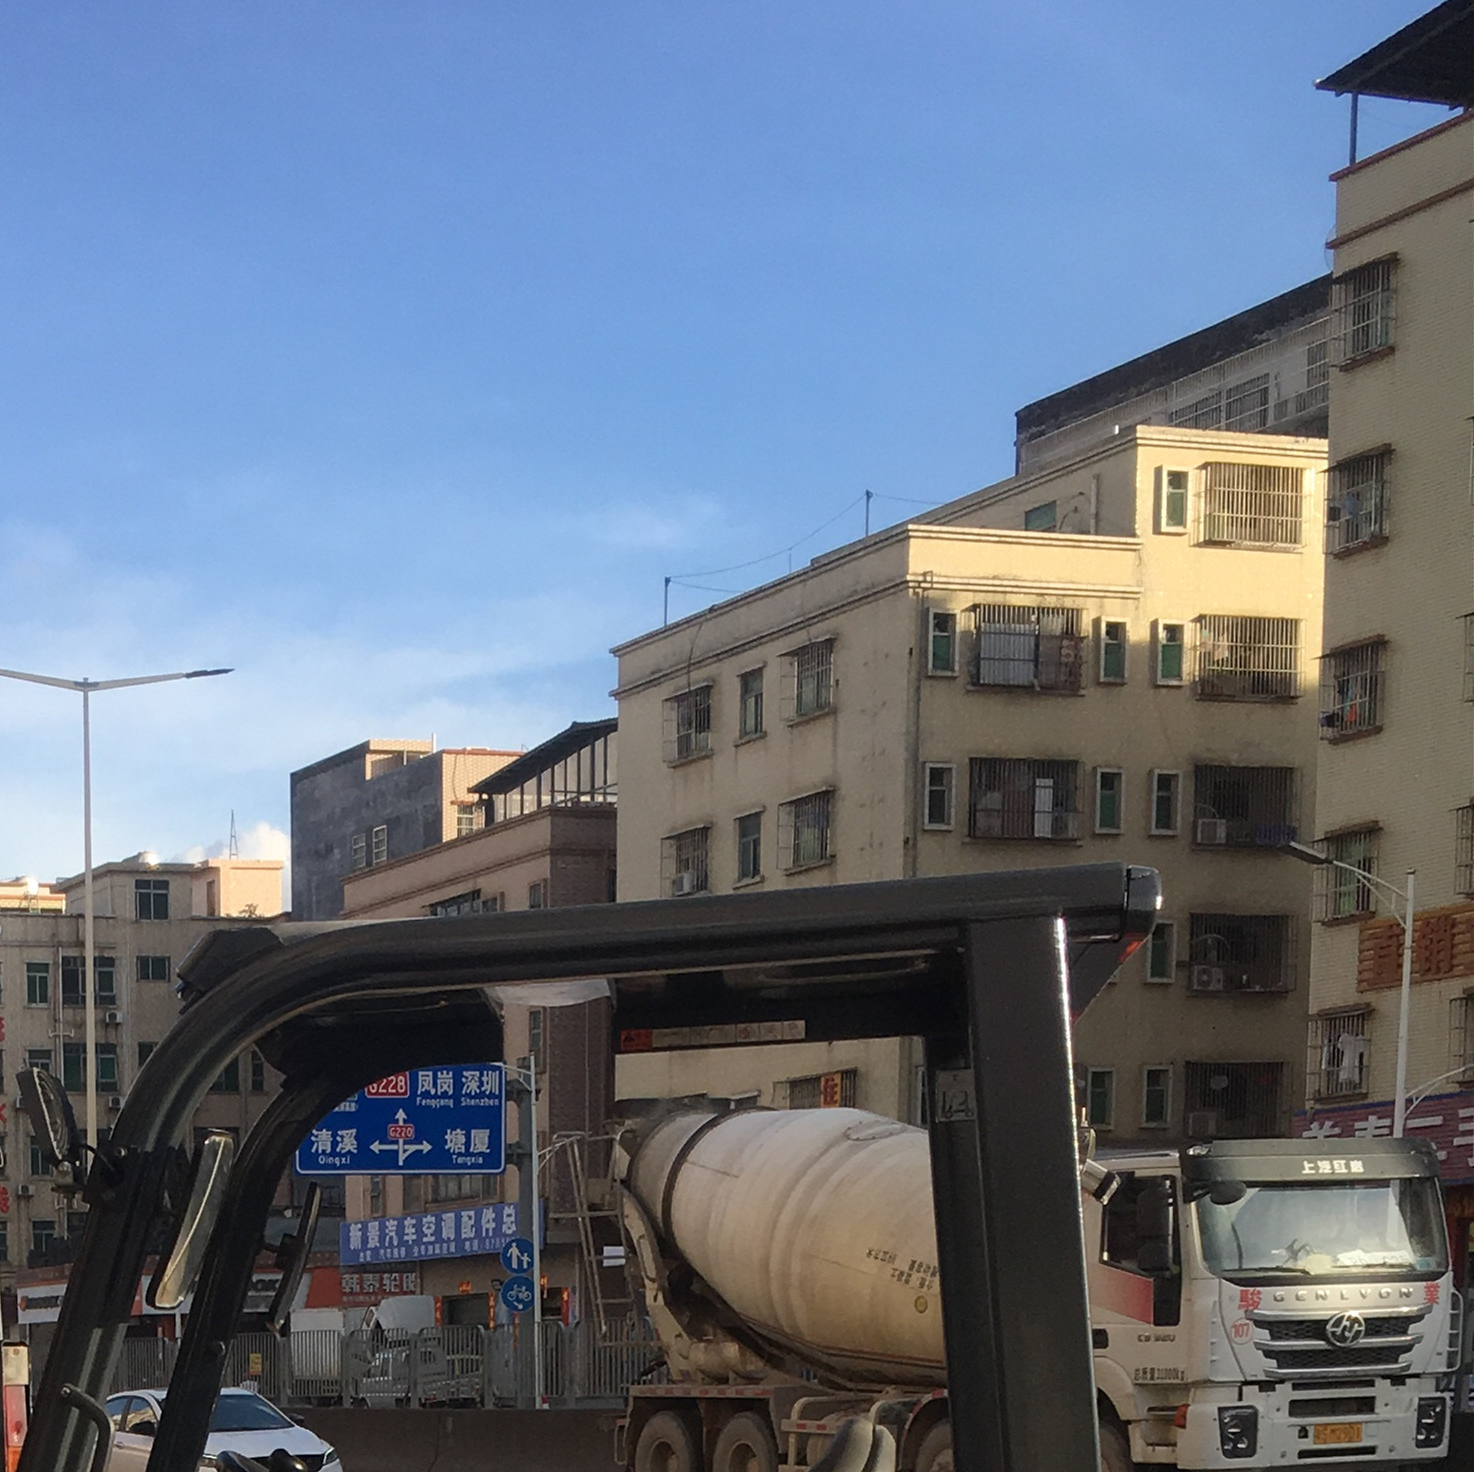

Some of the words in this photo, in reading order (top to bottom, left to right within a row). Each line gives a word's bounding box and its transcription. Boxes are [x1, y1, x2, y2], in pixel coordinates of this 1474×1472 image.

[417, 1071, 454, 1096] 凤岗
[462, 1071, 499, 1096] 深圳
[461, 1097, 499, 1106] Shenzhen
[311, 1129, 358, 1153] 清溪
[445, 1129, 490, 1153] 塘厦
[318, 1155, 350, 1166] Qingxi
[1232, 1323, 1250, 1338] 107
